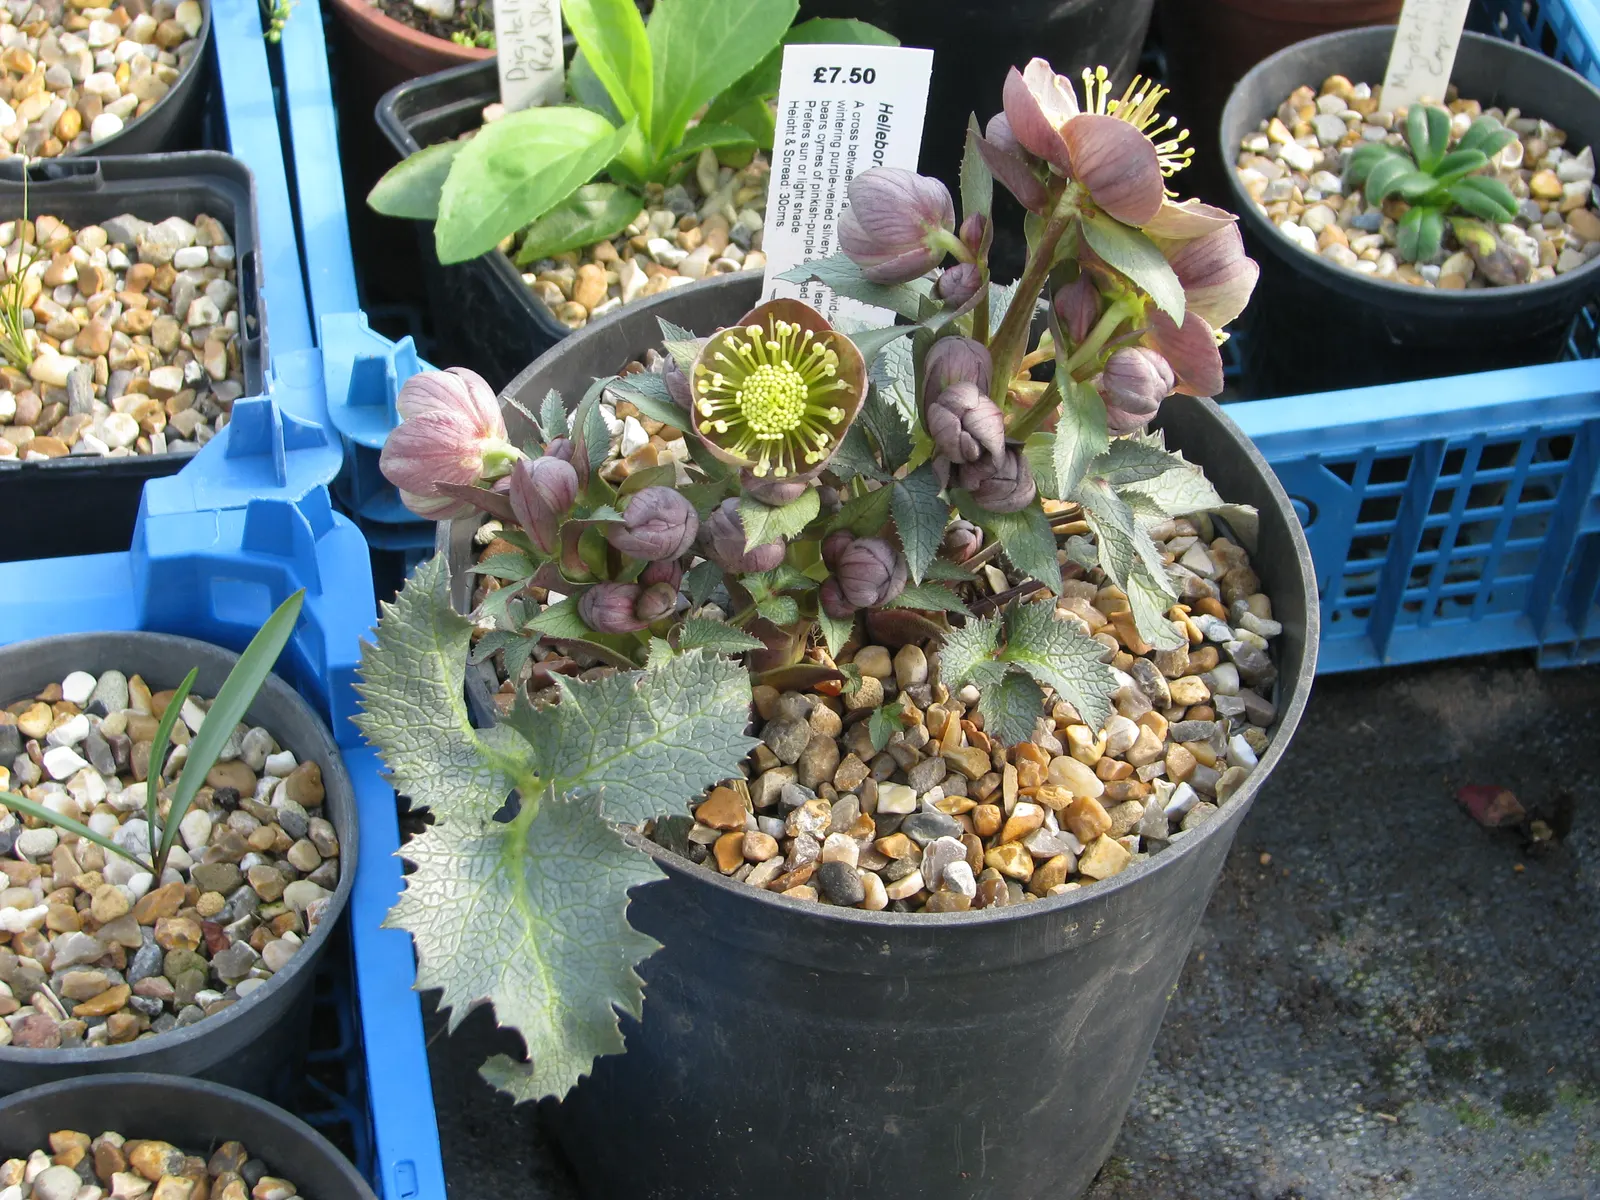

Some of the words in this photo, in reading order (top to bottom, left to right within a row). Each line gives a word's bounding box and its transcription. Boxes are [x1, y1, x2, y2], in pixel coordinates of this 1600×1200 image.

[501, 0, 536, 82] Digitali
[813, 67, 876, 84] £7.50
[818, 100, 831, 130] bears
[854, 100, 865, 109] A
[801, 100, 816, 139] Prefers
[830, 100, 846, 148] wintering
[850, 112, 861, 141] cross
[785, 138, 796, 147] &
[871, 102, 894, 169] Hellebor
[799, 142, 810, 161] sun
[814, 133, 826, 168] cymes
[798, 164, 807, 175] or
[812, 170, 823, 181] of
[793, 178, 808, 199] light
[824, 151, 840, 221] purple-veined
[803, 184, 819, 255] pinkish-purple
[814, 290, 825, 313] leav
